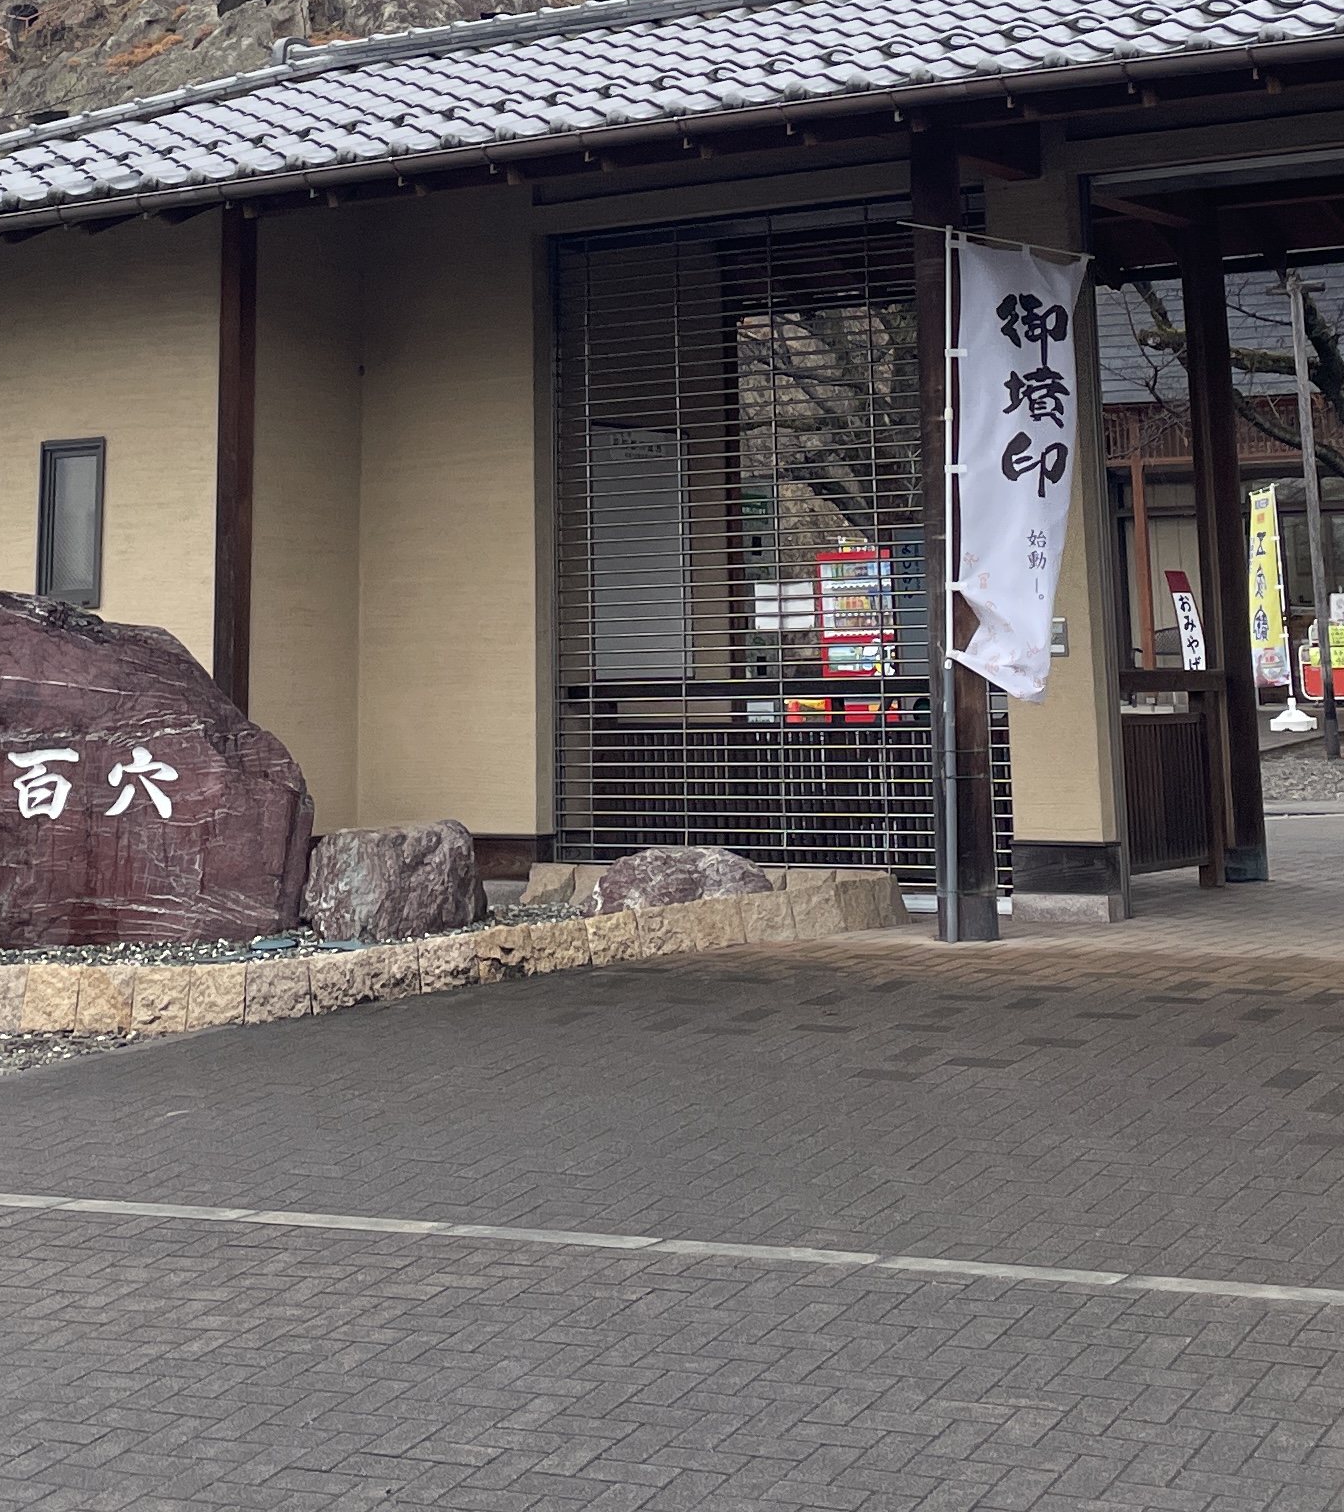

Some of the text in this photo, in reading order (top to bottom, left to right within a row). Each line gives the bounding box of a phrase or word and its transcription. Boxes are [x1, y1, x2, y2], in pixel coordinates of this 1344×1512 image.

[995, 293, 1070, 498] 御墳印
[1178, 594, 1202, 671] おみやげ
